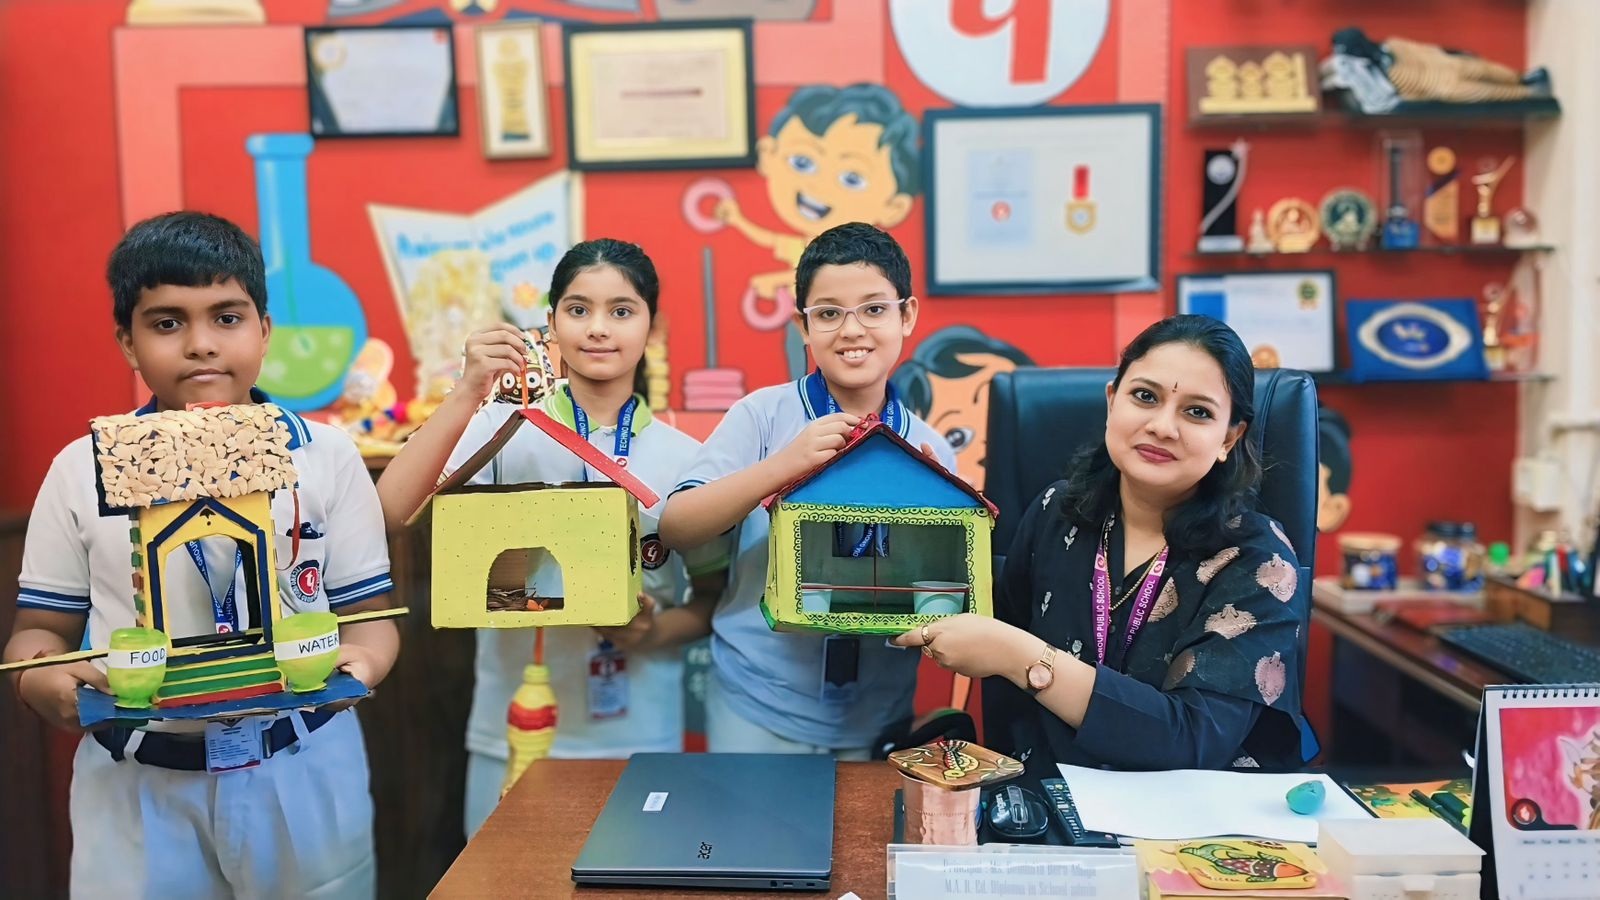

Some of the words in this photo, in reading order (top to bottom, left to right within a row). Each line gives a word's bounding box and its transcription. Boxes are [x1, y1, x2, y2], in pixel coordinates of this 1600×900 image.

[620, 426, 629, 452] TECHNO
[1096, 574, 1105, 604] SCHOOL
[1096, 605, 1105, 632] PUBLIC
[1129, 608, 1146, 635] PUBLIC
[1138, 579, 1156, 609] SCHOOL
[130, 647, 166, 664] FOOD
[298, 633, 339, 654] WATER
[697, 841, 713, 859] acer
